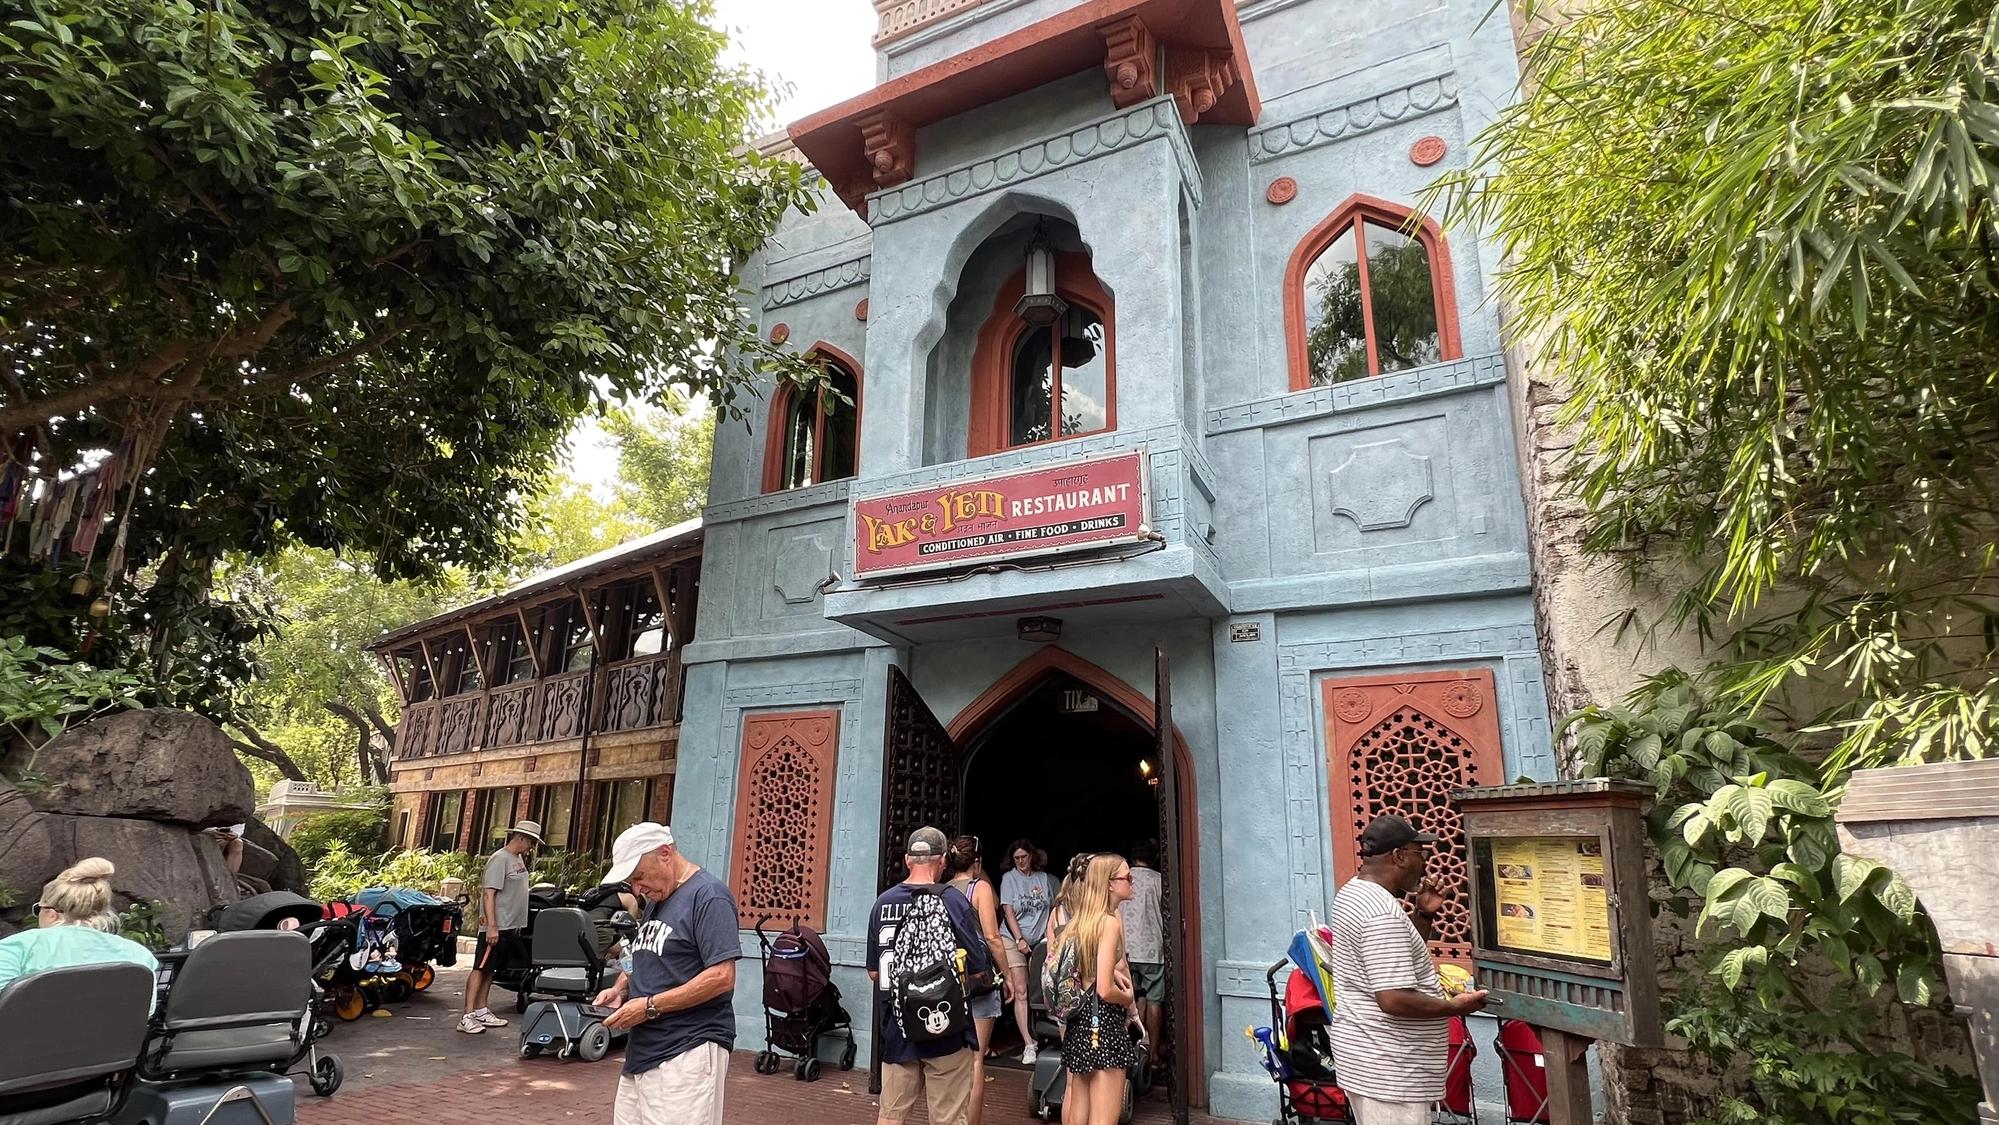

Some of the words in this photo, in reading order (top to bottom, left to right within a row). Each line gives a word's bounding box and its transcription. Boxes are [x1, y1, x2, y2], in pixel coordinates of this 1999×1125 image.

[861, 514, 919, 554] YAK
[919, 513, 938, 537] &
[936, 490, 1008, 534] YETI
[1011, 483, 1131, 517] RESTAURANT
[922, 538, 986, 554] CONDITIONED
[988, 533, 1005, 543] AIR
[1015, 528, 1038, 540] FINE
[1040, 524, 1069, 537] FOOD
[1080, 516, 1119, 531] DRINKS
